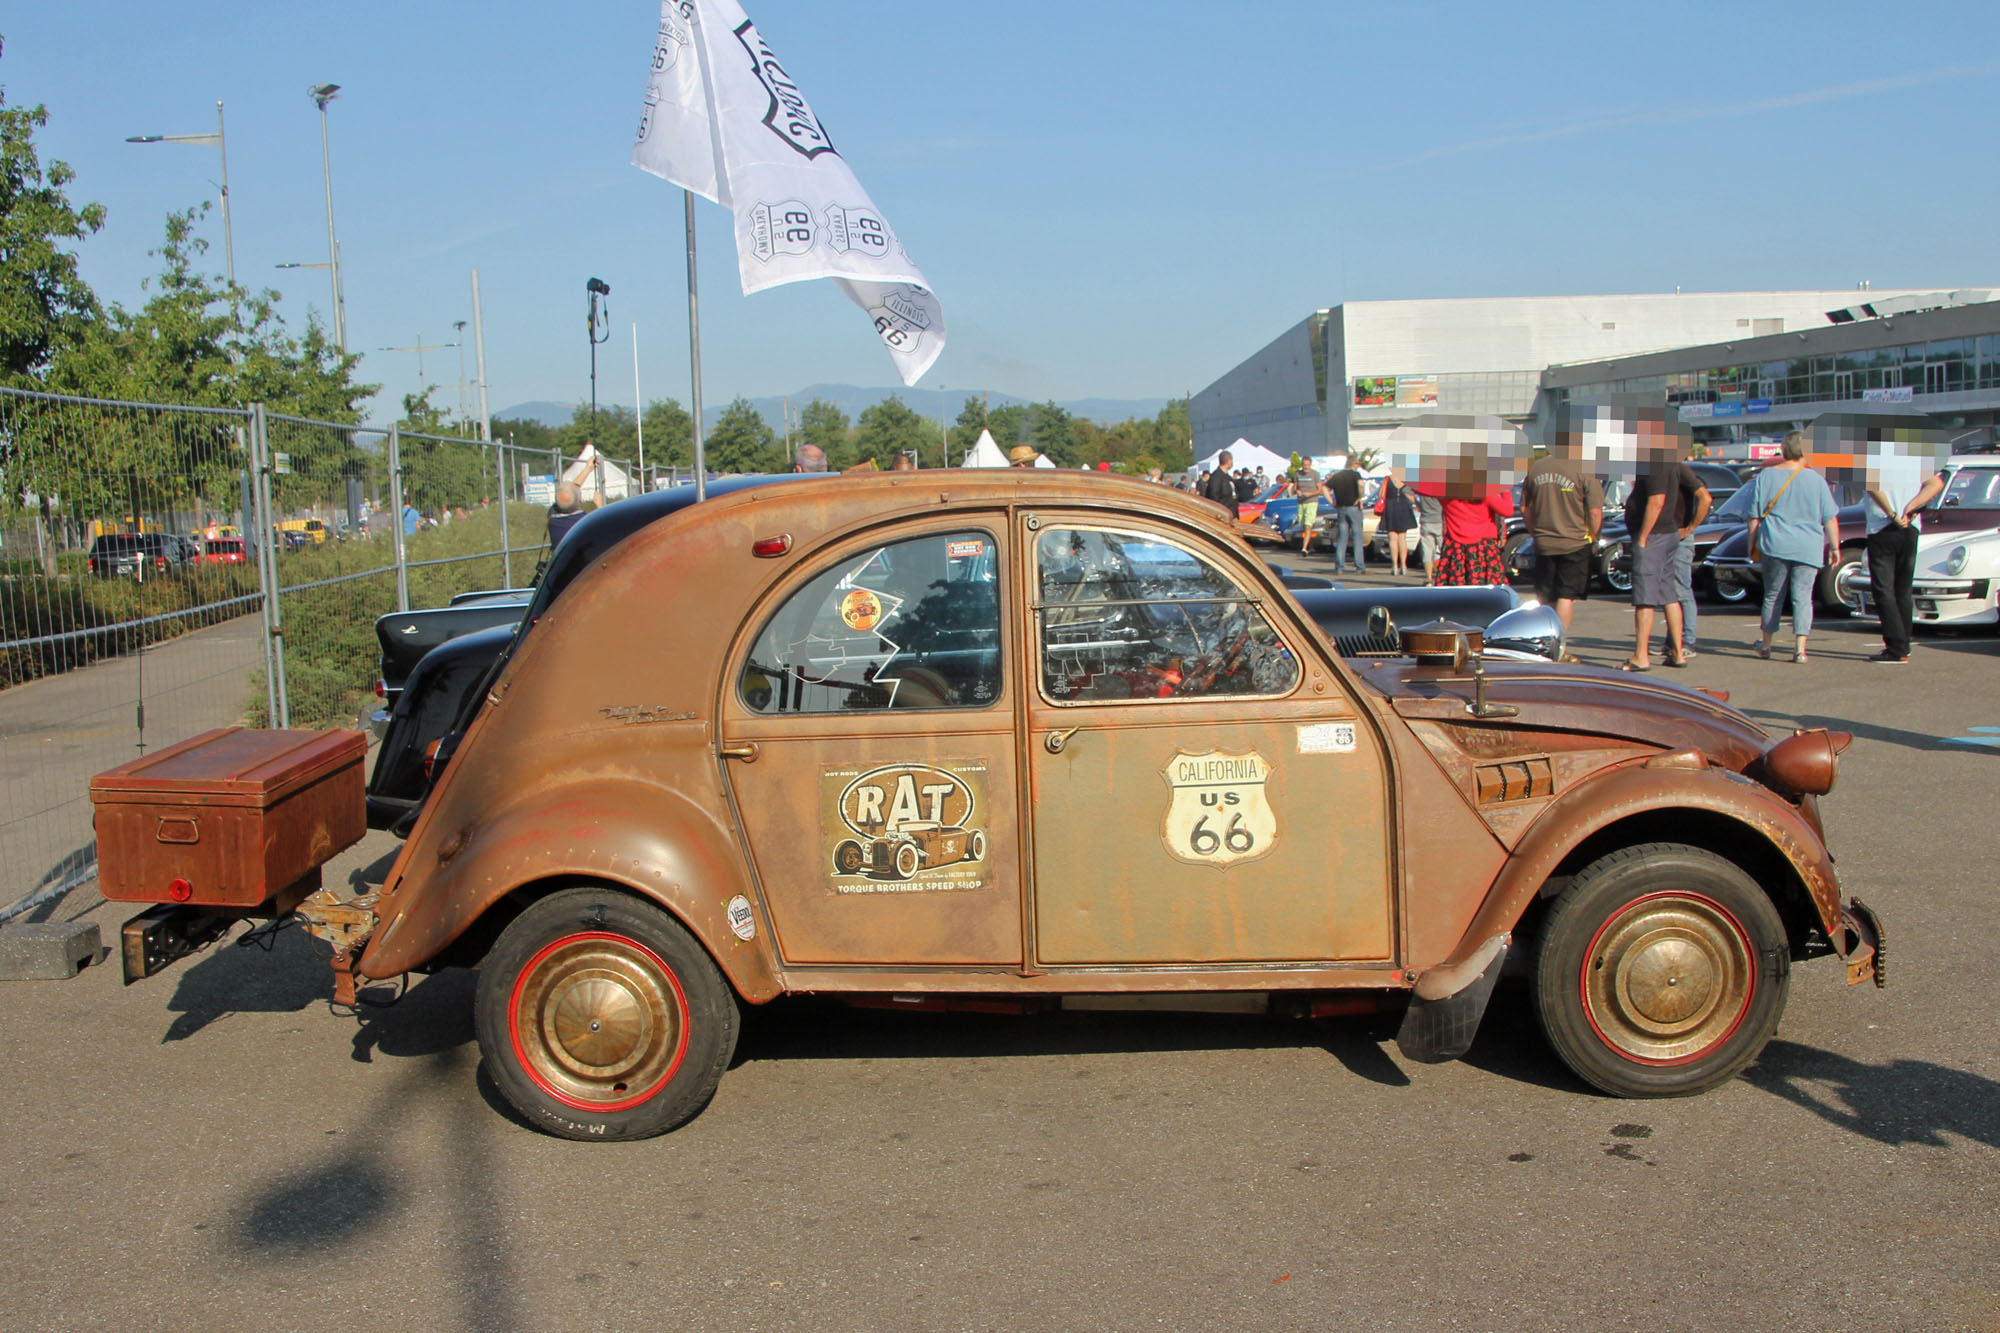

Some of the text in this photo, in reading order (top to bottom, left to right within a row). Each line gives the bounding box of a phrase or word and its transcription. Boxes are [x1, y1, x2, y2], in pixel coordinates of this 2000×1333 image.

[891, 299, 924, 323] ILLINOIS
[874, 316, 908, 346] 66
[1178, 759, 1258, 782] CALIFORNIA
[856, 773, 955, 832] RAT
[1200, 791, 1241, 806] US
[1190, 812, 1254, 855] 66
[838, 880, 982, 894] TORQUE BROTHERS SPEED SHOP
